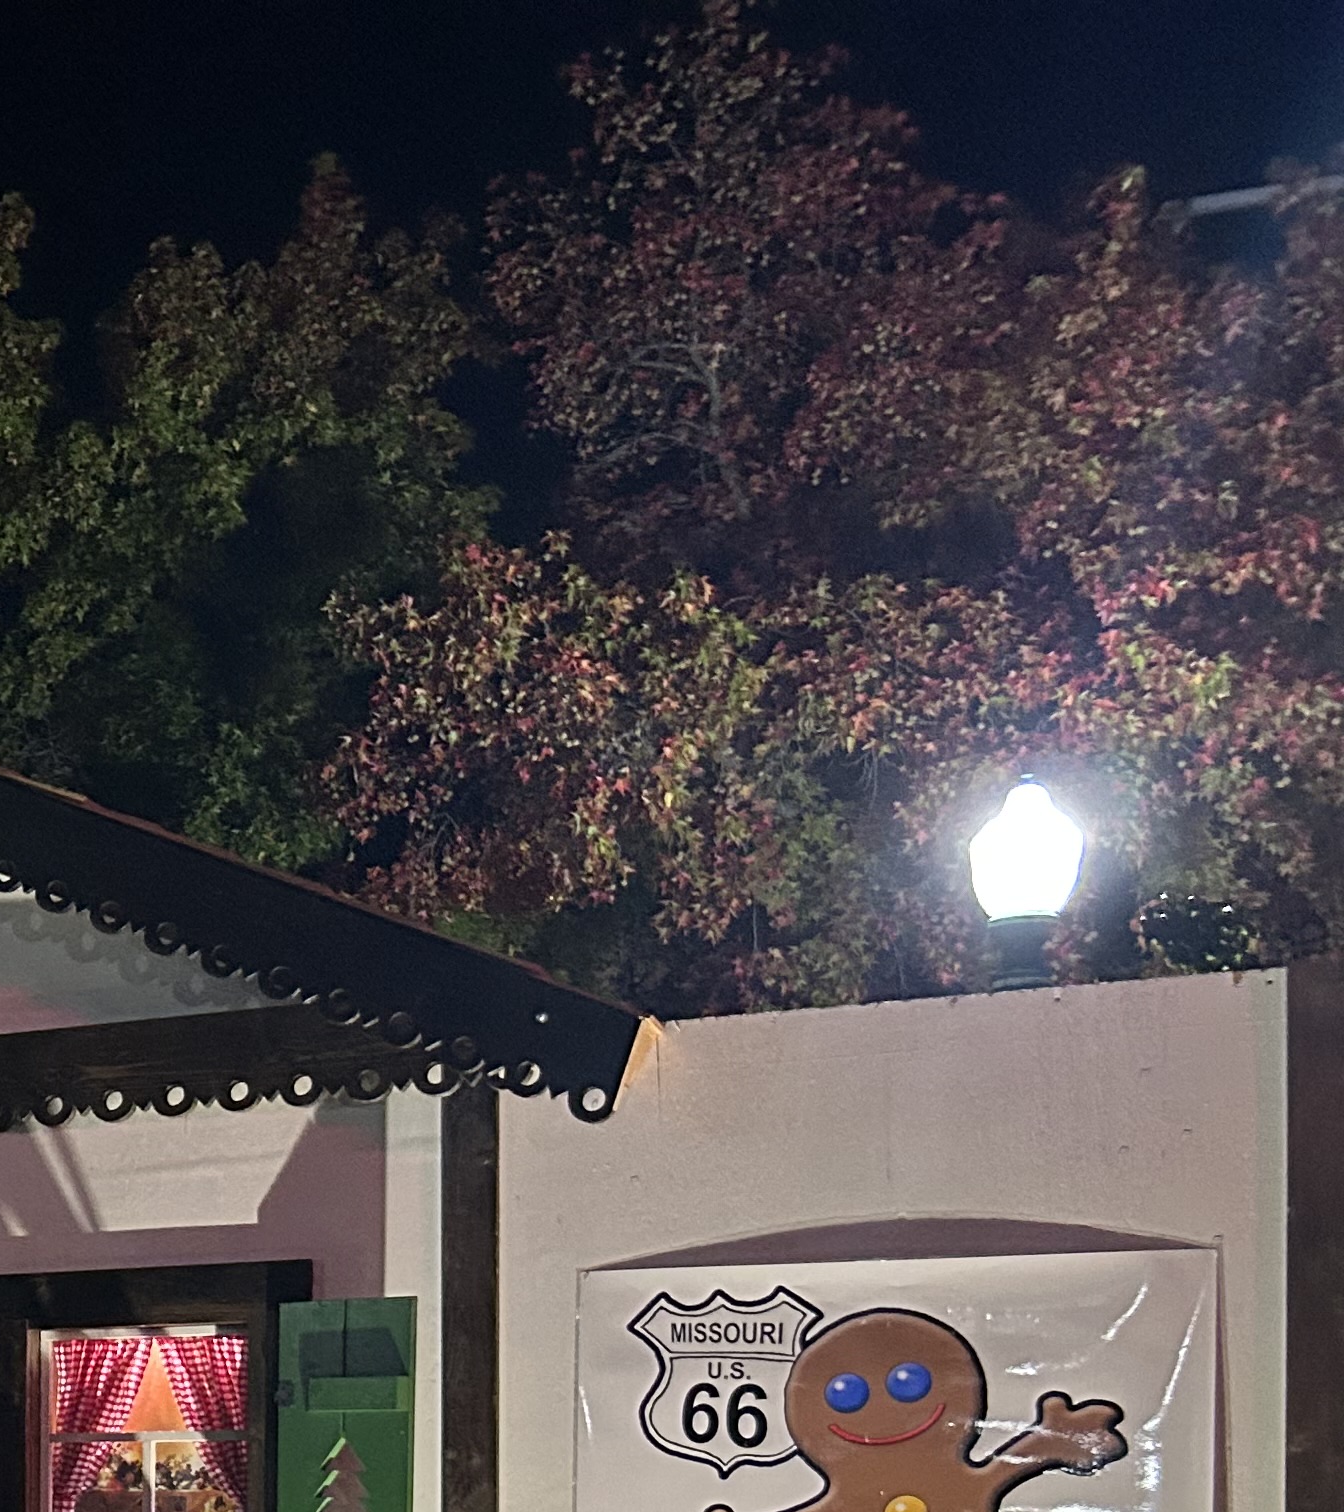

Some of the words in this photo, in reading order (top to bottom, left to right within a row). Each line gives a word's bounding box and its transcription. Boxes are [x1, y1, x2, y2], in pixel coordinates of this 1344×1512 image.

[671, 1322, 784, 1345] MISSOURI
[707, 1361, 752, 1380] U.S.
[681, 1382, 768, 1449] 66
